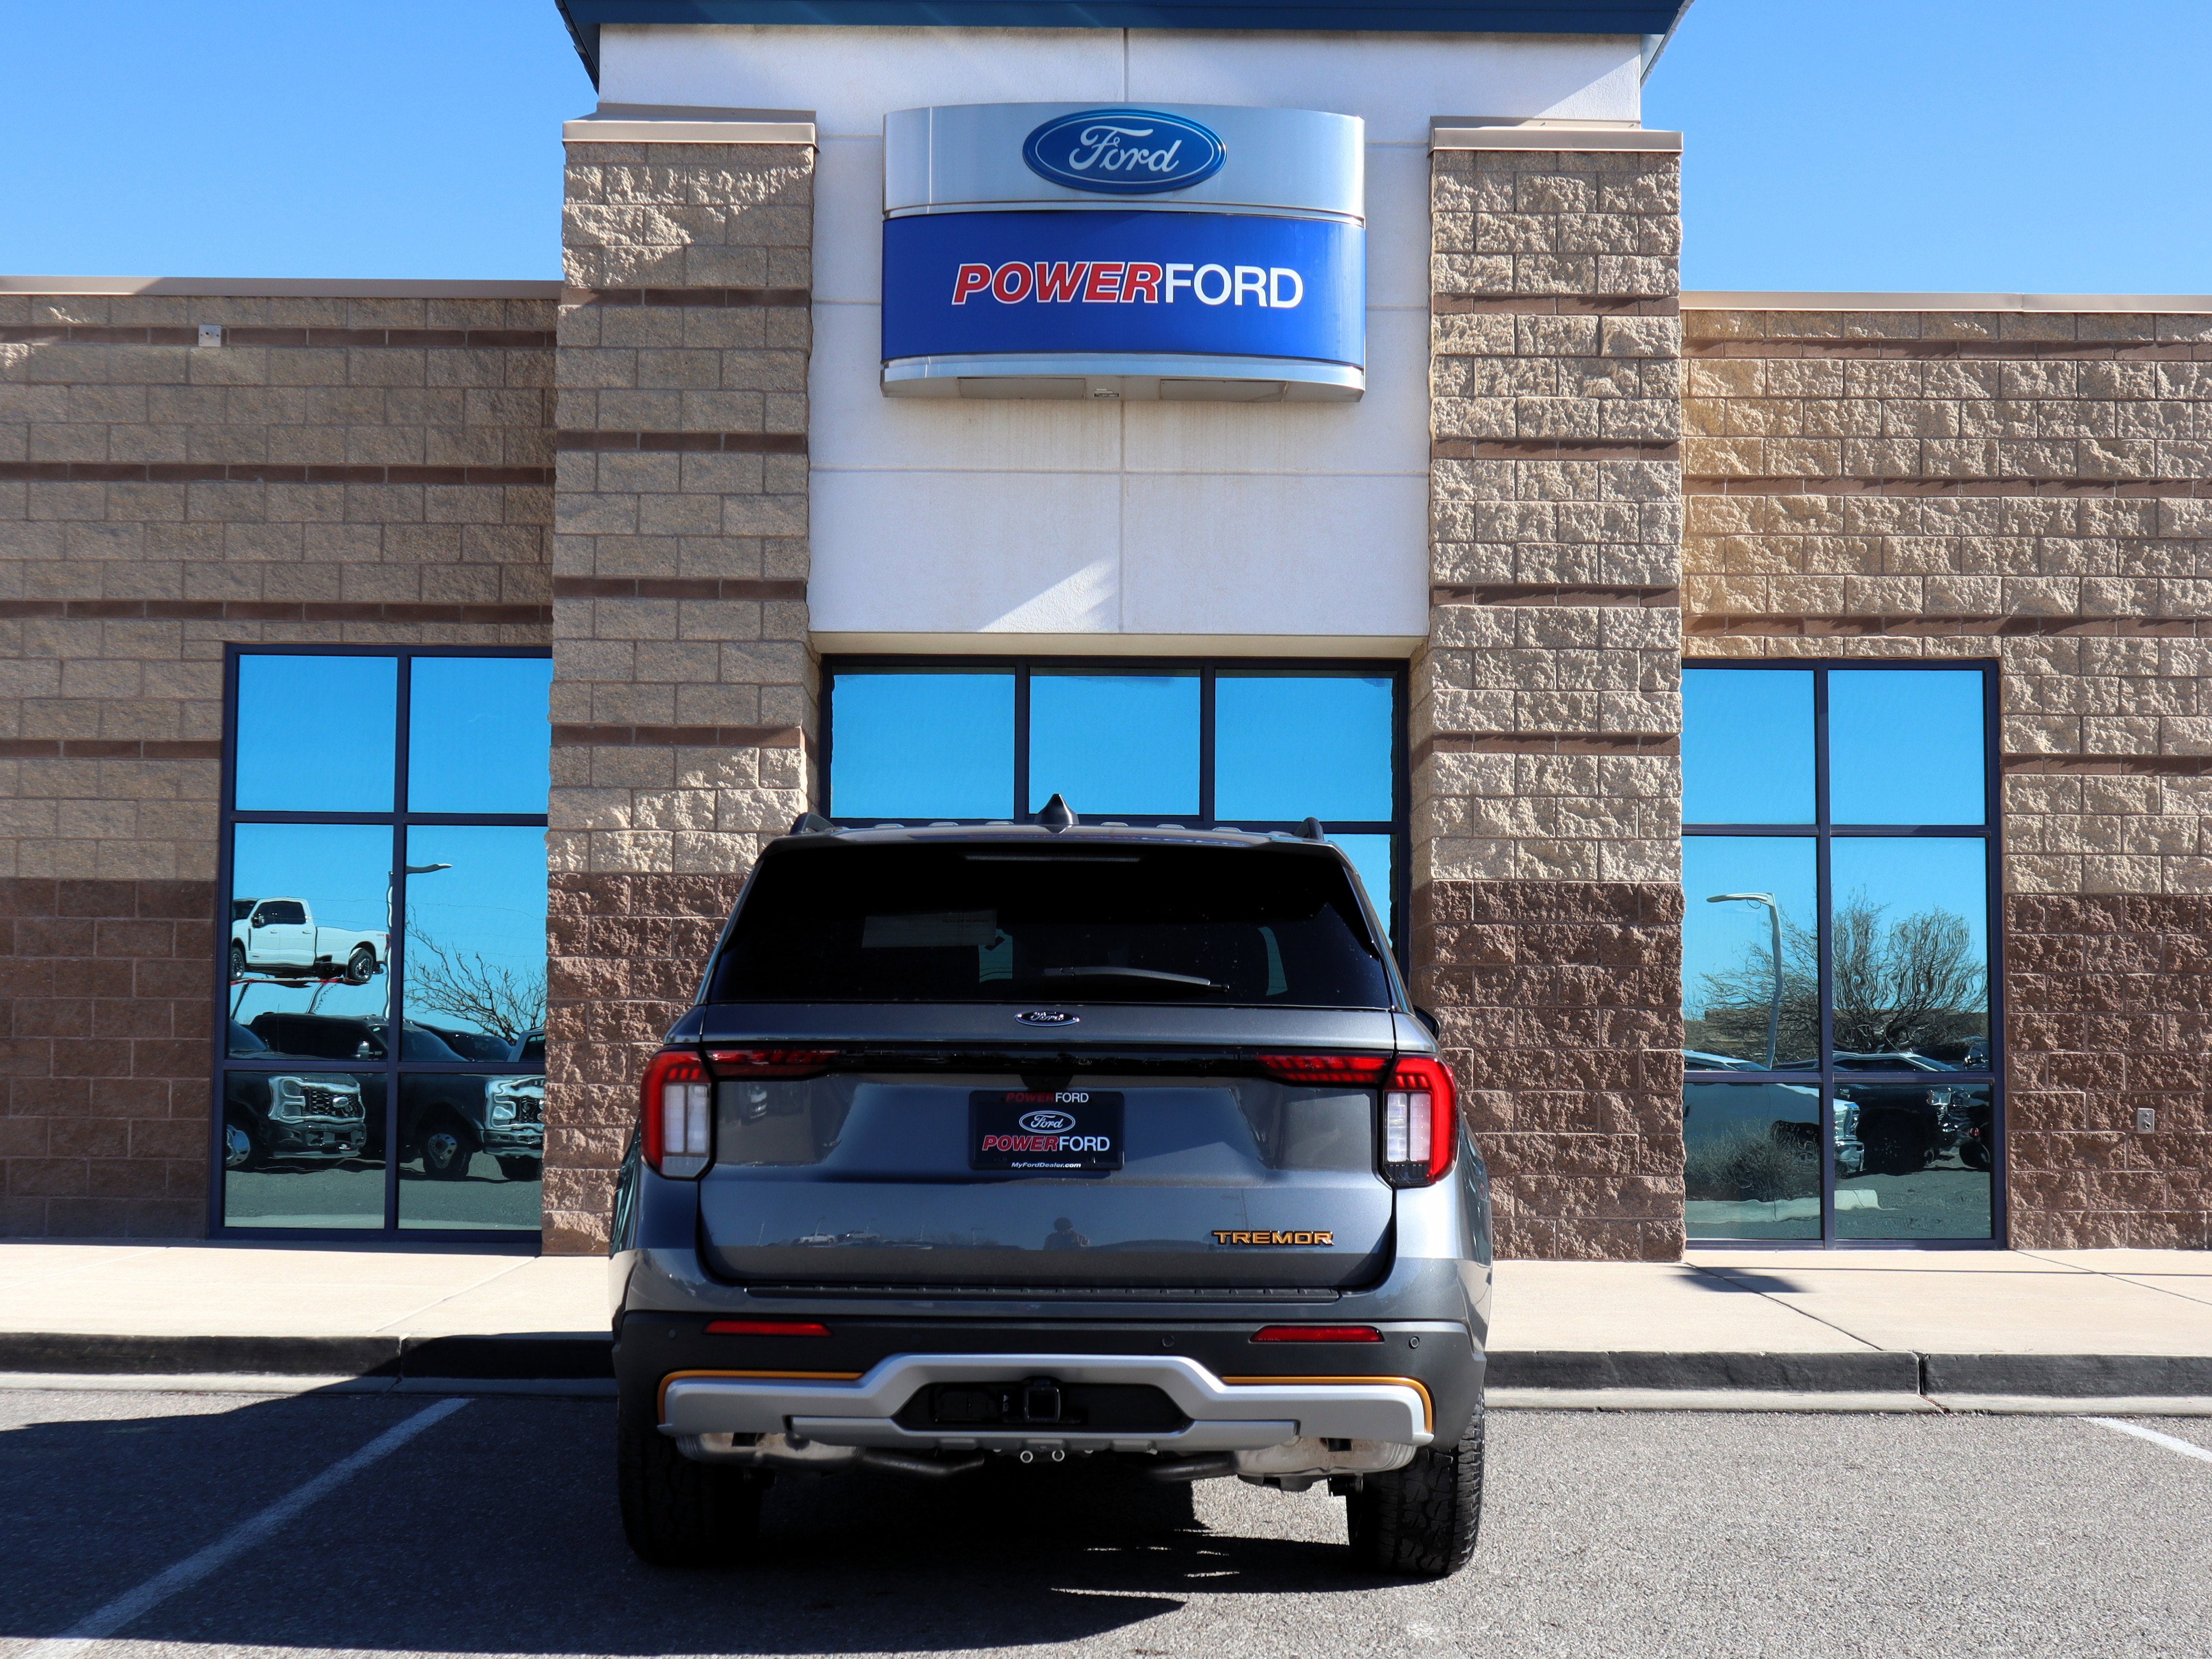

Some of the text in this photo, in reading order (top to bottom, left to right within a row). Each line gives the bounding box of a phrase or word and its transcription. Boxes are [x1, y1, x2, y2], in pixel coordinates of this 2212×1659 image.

[1068, 125, 1182, 172] Ford
[951, 261, 1304, 308] POWERFORD
[1030, 1012, 1064, 1021] Ford
[1006, 1092, 1089, 1103] POWERFORD
[1031, 1113, 1063, 1129] Ford
[982, 1136, 1110, 1152] POWERFORD
[1212, 1230, 1334, 1245] TREMOR
